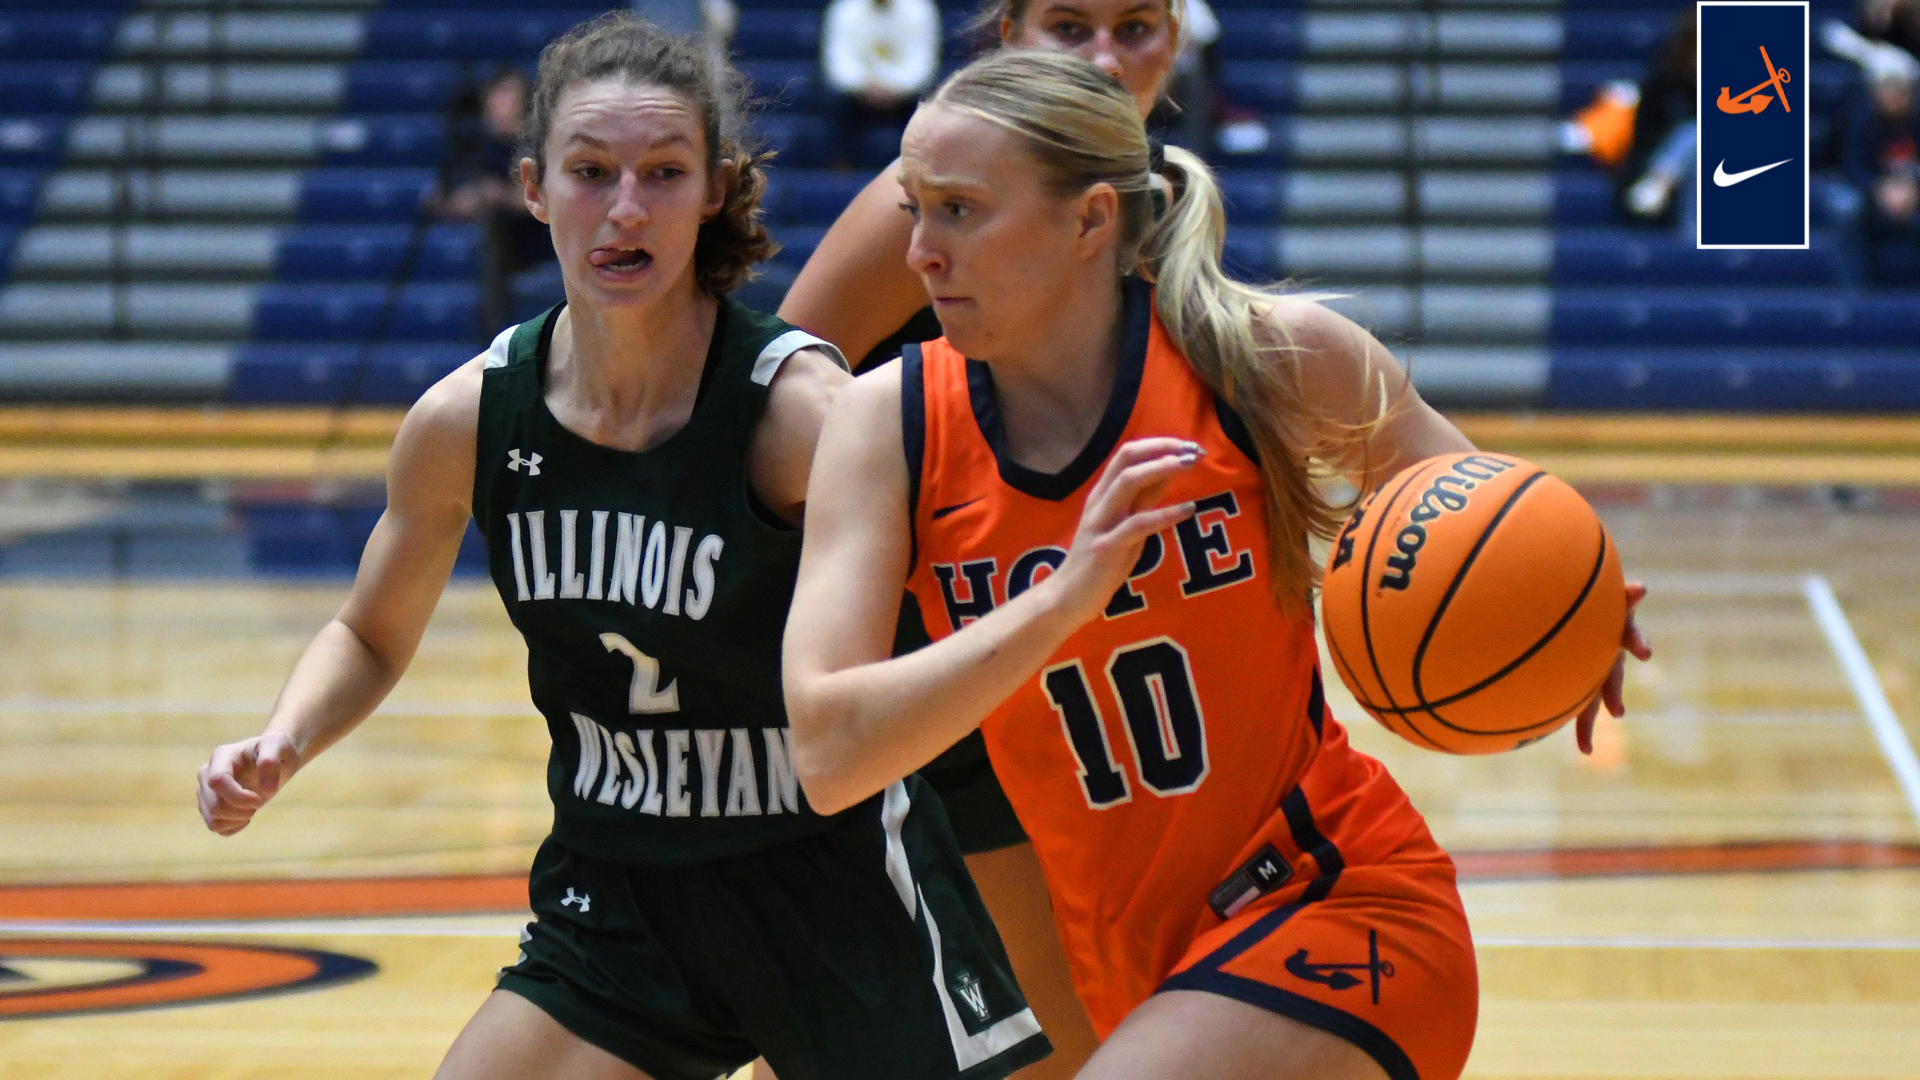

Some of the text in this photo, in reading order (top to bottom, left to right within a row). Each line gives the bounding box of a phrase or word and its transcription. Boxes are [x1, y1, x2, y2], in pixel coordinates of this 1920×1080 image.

[507, 509, 725, 621] ILLINOIS
[1379, 455, 1517, 591] Wilson
[598, 631, 681, 715] 2
[1039, 635, 1211, 810] 10
[569, 711, 800, 818] WESLEYAN
[1257, 859, 1278, 881] M
